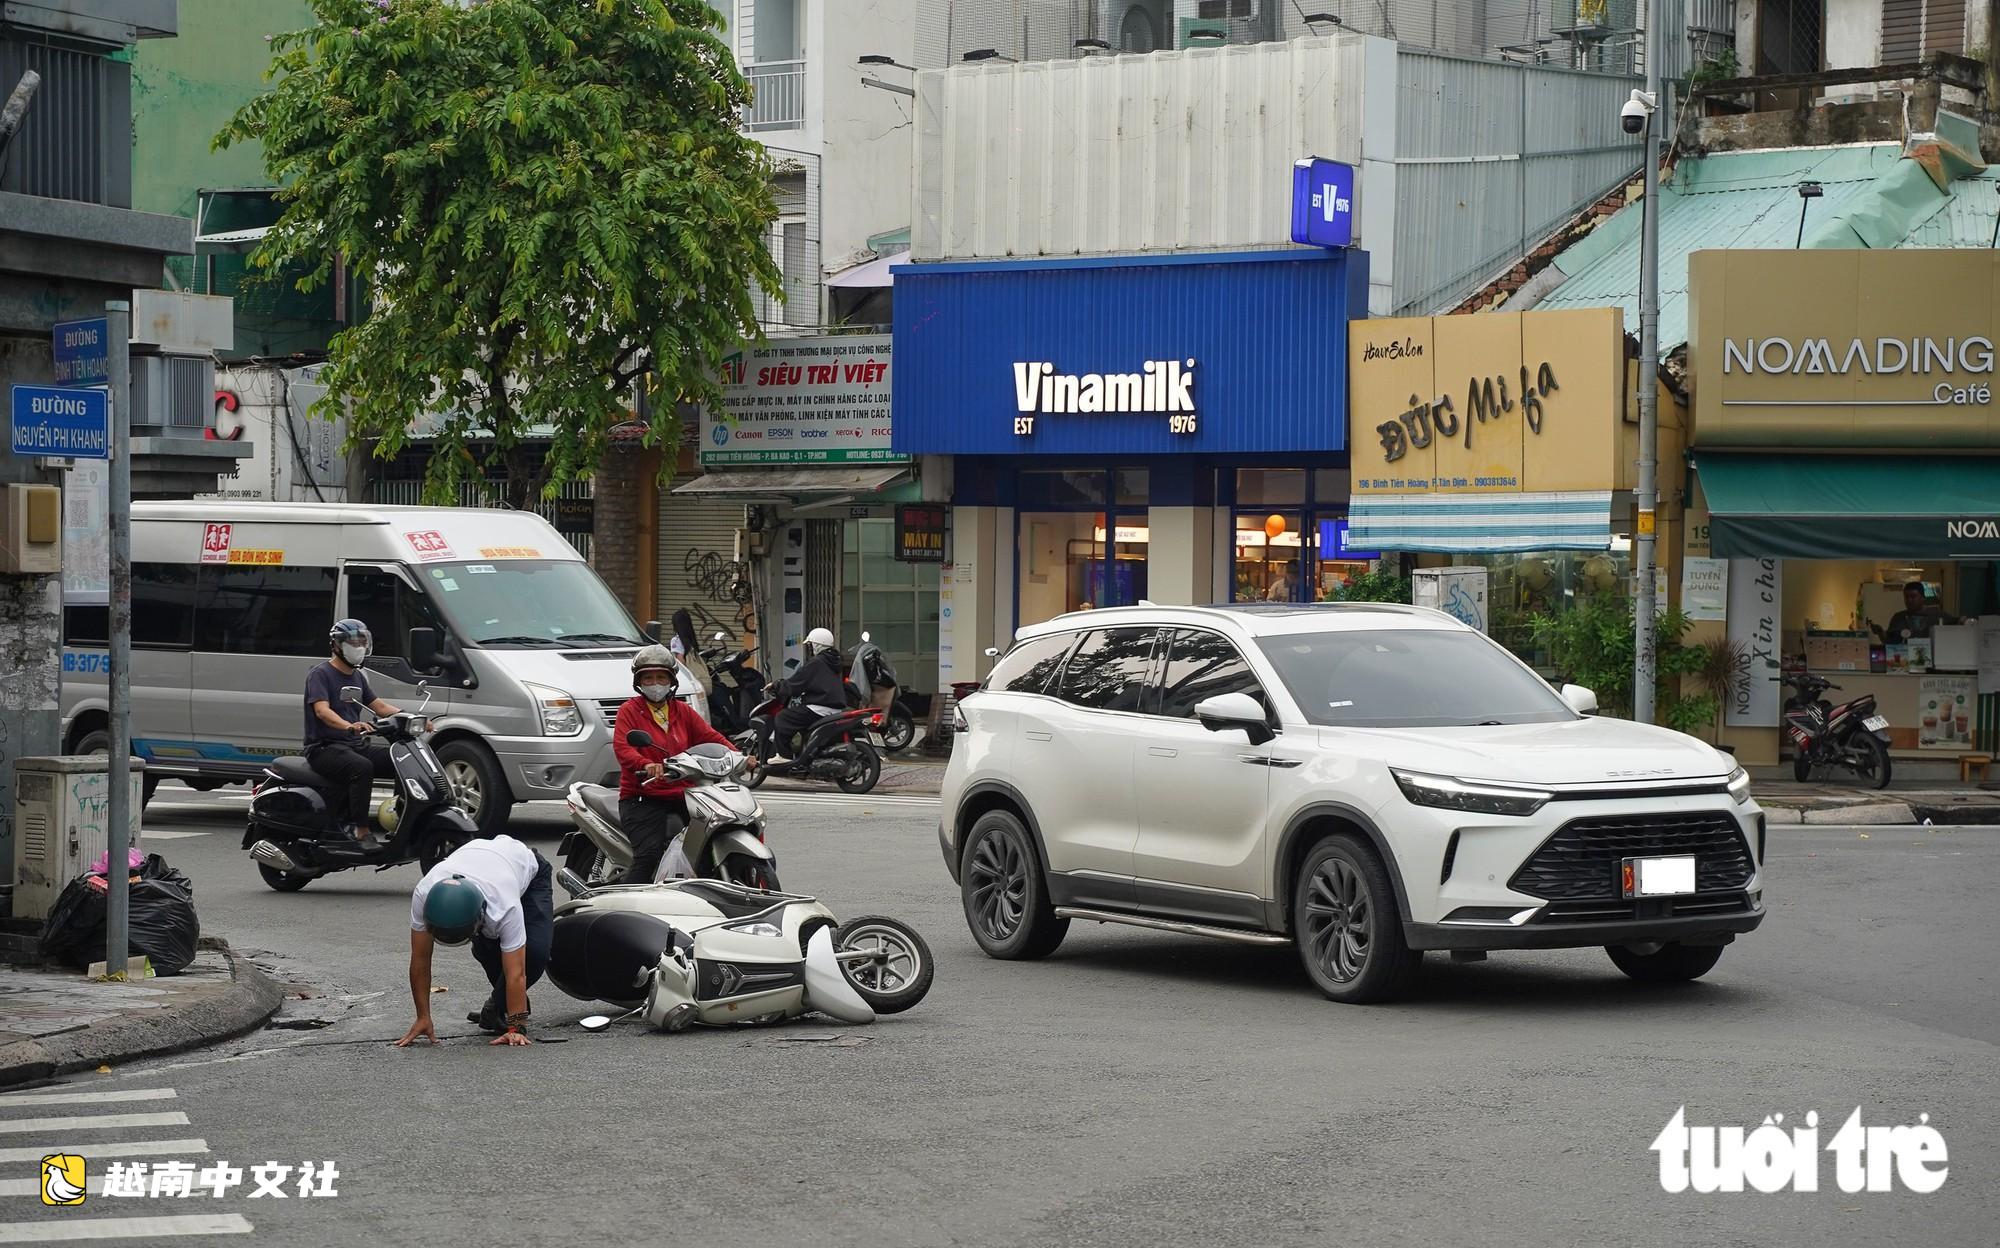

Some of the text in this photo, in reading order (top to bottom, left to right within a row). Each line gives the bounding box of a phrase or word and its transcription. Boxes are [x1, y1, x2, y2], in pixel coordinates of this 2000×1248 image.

[1312, 183, 1350, 222] EST V 1976
[65, 328, 98, 347] ĐƯỜNG
[754, 348, 770, 358] CÔNG
[771, 348, 778, 358] TY
[780, 348, 794, 357] TNHH
[857, 343, 874, 355] CÔNG
[1723, 336, 1995, 374] NOMADING
[757, 358, 888, 389] SIÊU TRÍ VIỆT
[787, 394, 801, 406] MÁY
[803, 395, 812, 405] IN
[814, 393, 836, 405] CHÍNH
[858, 392, 873, 404] CÁC
[1933, 382, 1991, 404] Café
[31, 395, 87, 416] ĐƯỜNG
[738, 410, 753, 421] MÁY
[798, 410, 815, 421] LINH
[835, 408, 850, 420] MÁY
[852, 407, 869, 419] TÍNH
[870, 408, 886, 419] CÁC
[767, 428, 793, 437] EPSON
[800, 429, 828, 439] brother
[1014, 414, 1196, 435] EST 1976
[1376, 393, 1460, 463] ĐỨC
[53, 427, 69, 448] PHI
[70, 428, 104, 449] KHANH
[735, 430, 763, 440] Canon
[1358, 479, 1370, 489] 196
[1372, 478, 1389, 489] Đinh
[1391, 478, 1405, 489] Tiên
[1407, 478, 1429, 490] Hoàng
[1452, 477, 1468, 490] Định
[904, 530, 942, 548] MÁY IN
